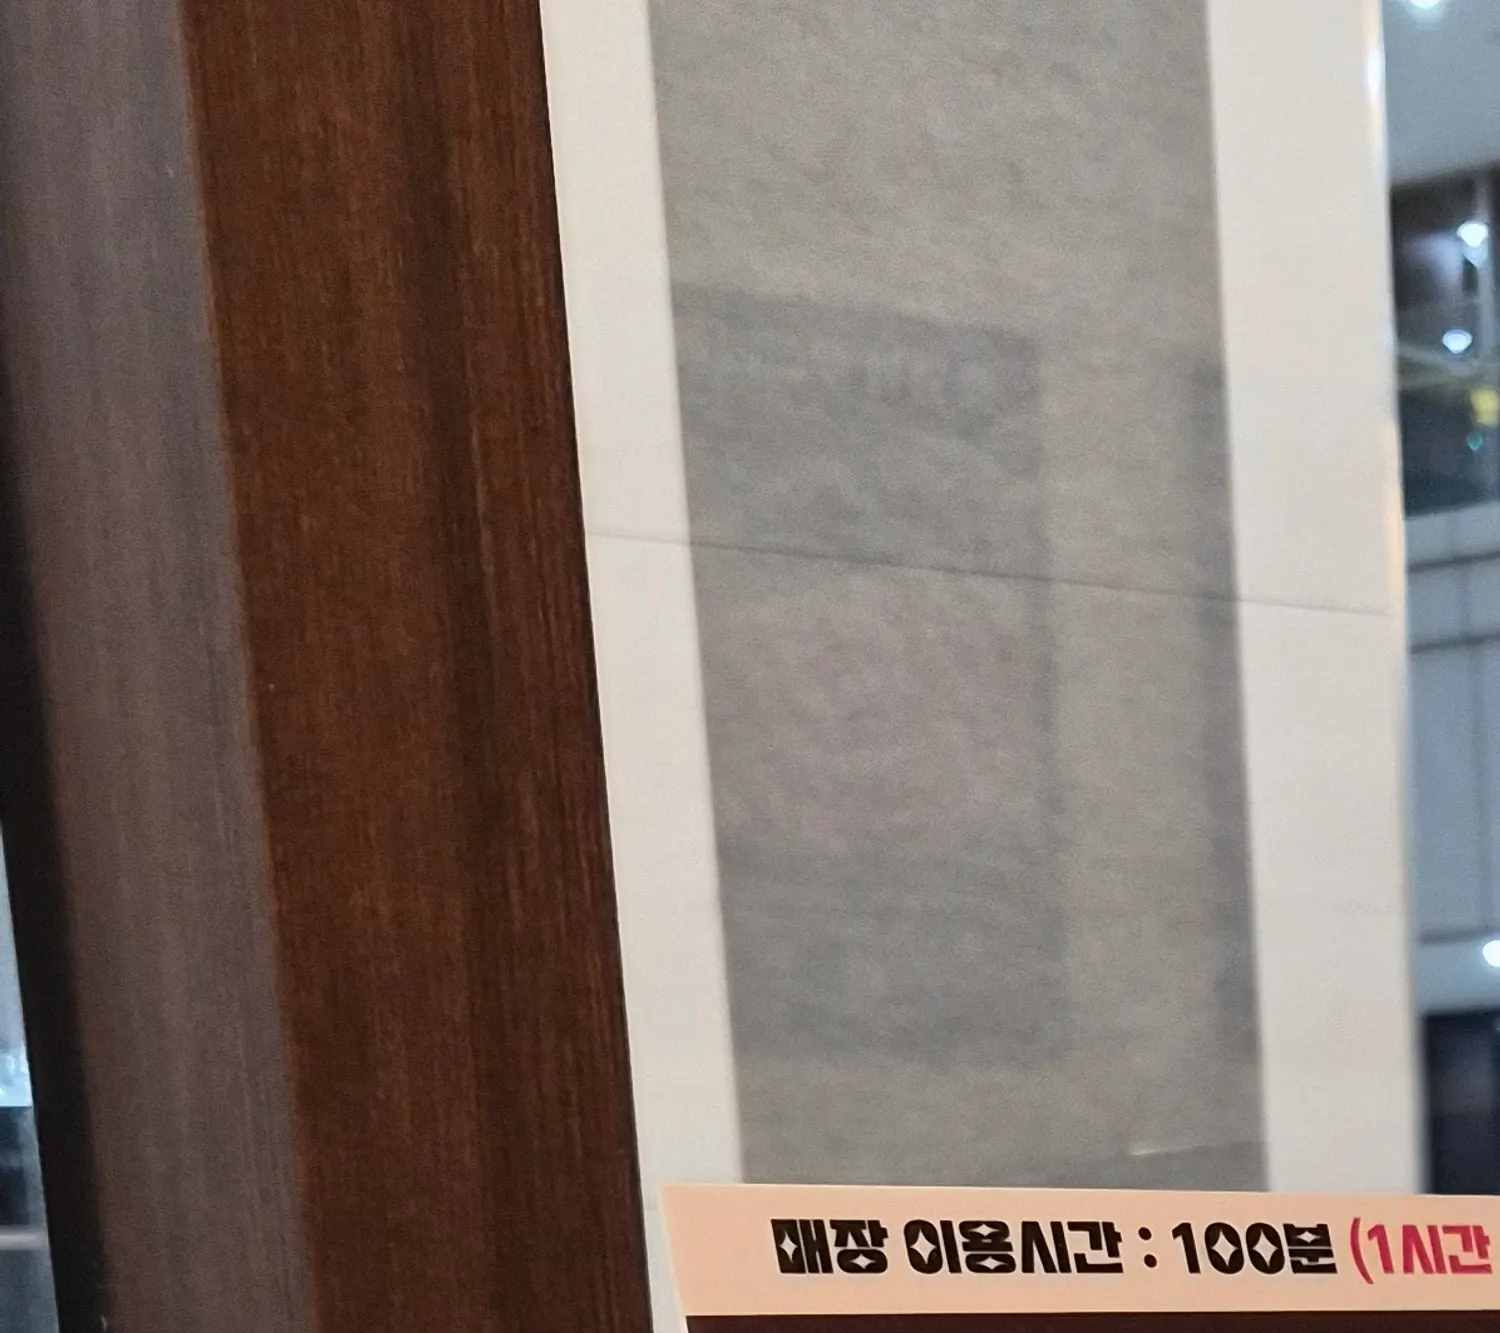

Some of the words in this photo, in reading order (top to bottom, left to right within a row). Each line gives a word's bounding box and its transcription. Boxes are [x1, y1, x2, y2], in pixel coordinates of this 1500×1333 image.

[770, 1218, 890, 1274] 매장
[903, 1219, 1123, 1275] 이용시간
[1171, 1222, 1338, 1275] 100분
[1350, 1217, 1492, 1284] (1시간
